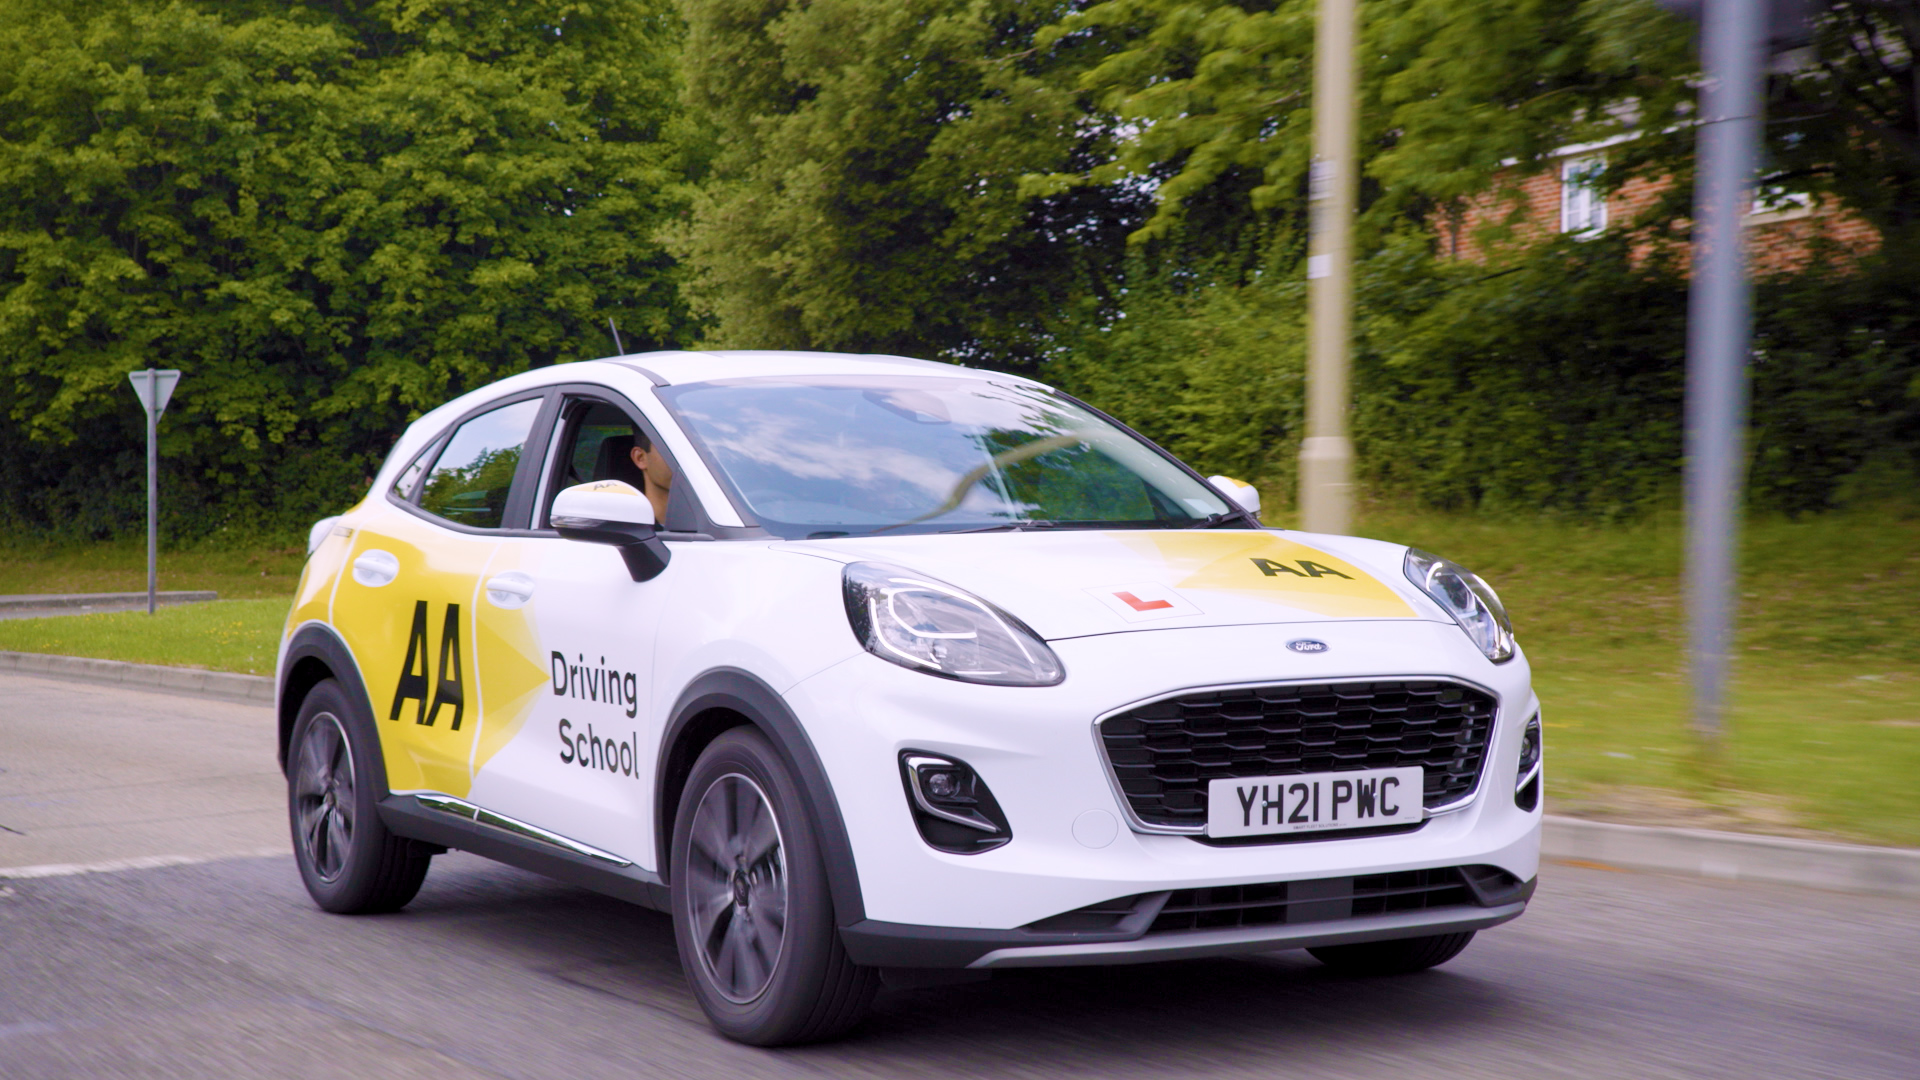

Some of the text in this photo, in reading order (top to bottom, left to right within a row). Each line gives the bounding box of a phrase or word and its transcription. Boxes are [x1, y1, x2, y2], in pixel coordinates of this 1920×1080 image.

[1249, 558, 1355, 580] AA
[1112, 591, 1174, 612] L
[389, 600, 464, 731] AA
[1295, 641, 1323, 651] Ford
[551, 650, 638, 719] Driving
[558, 718, 640, 780] School
[1236, 776, 1400, 827] YH21 PWC
